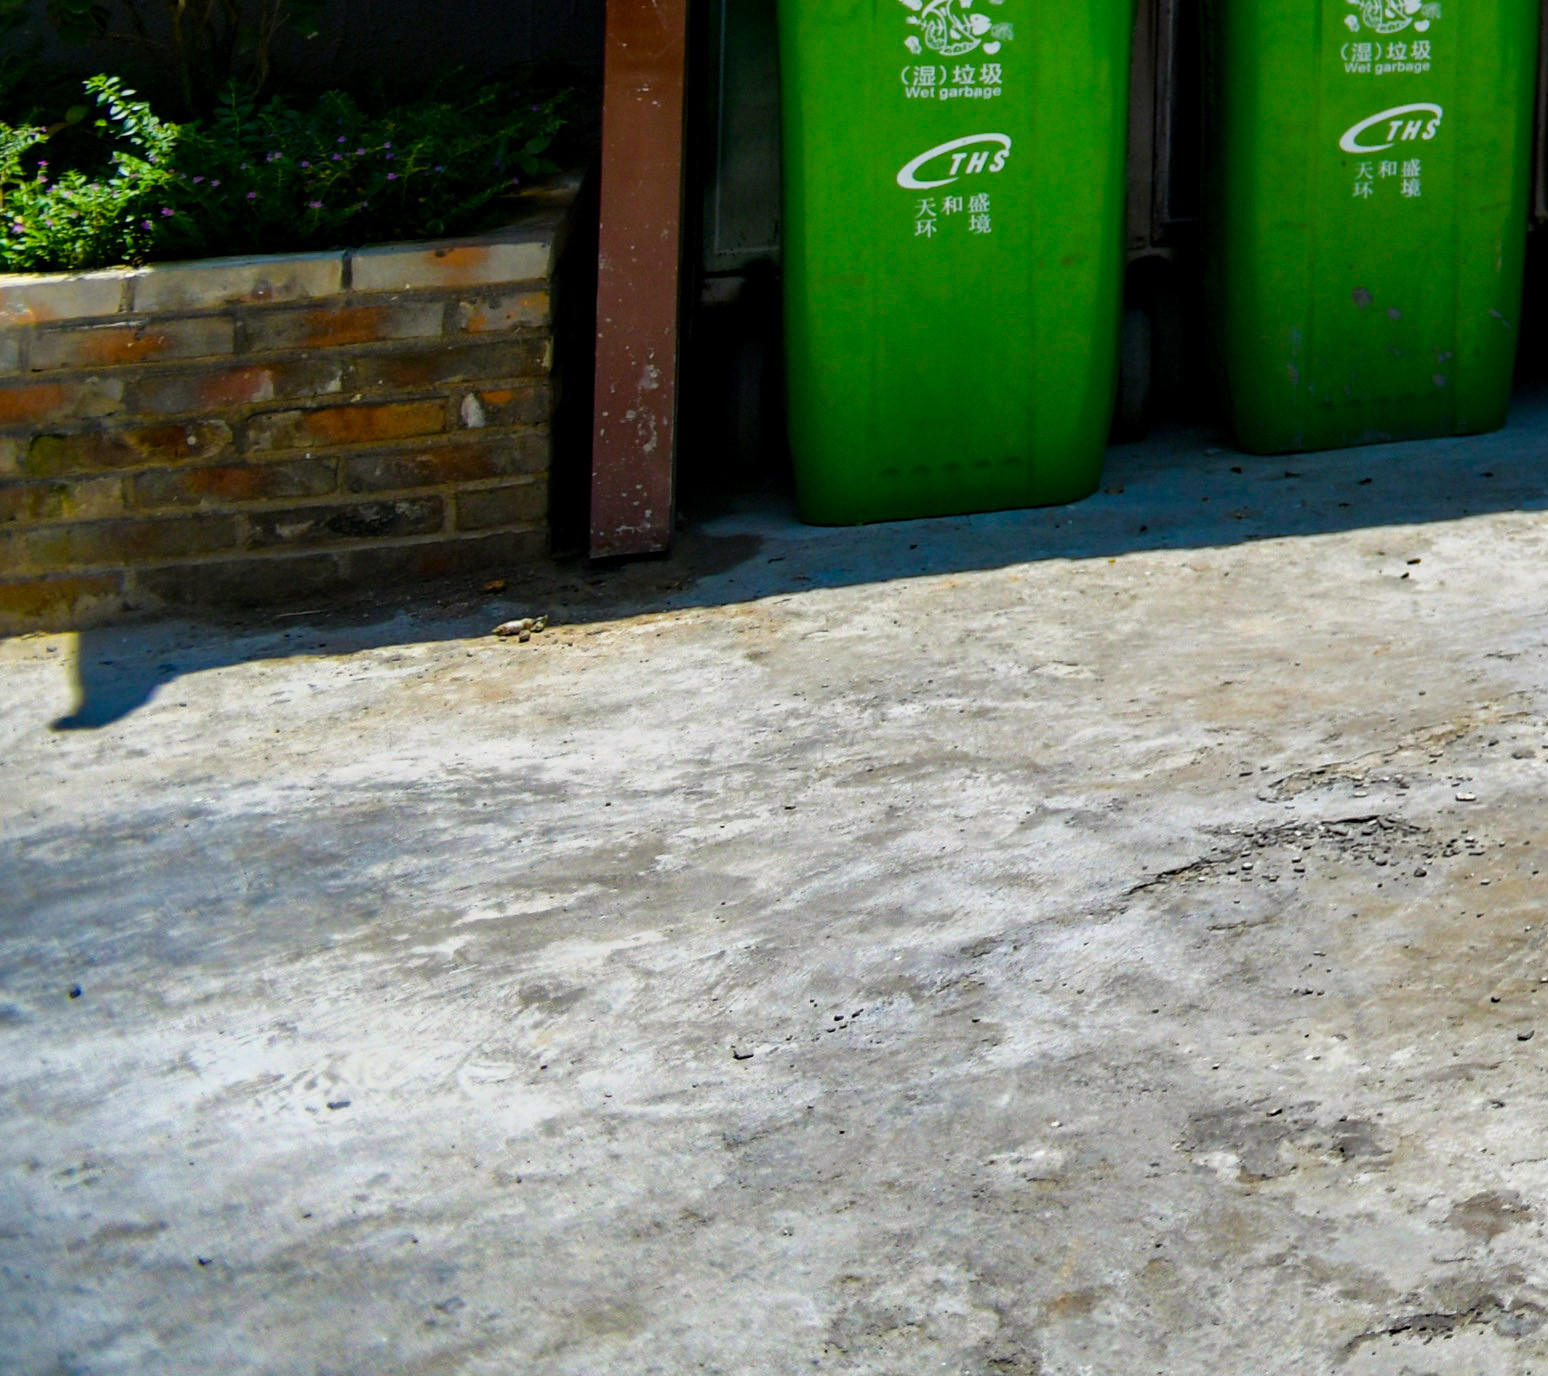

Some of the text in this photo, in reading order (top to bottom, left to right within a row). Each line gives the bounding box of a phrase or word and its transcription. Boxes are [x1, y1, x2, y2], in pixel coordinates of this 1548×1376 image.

[1344, 62, 1431, 76] Wet garbage
[905, 86, 1002, 101] Wet garbage
[1386, 118, 1441, 143] THS
[949, 149, 1010, 176] THS
[1354, 158, 1422, 181] 天和盛
[1352, 179, 1422, 200] 环境
[914, 192, 991, 219] 天和盛
[914, 214, 992, 239] 环境
